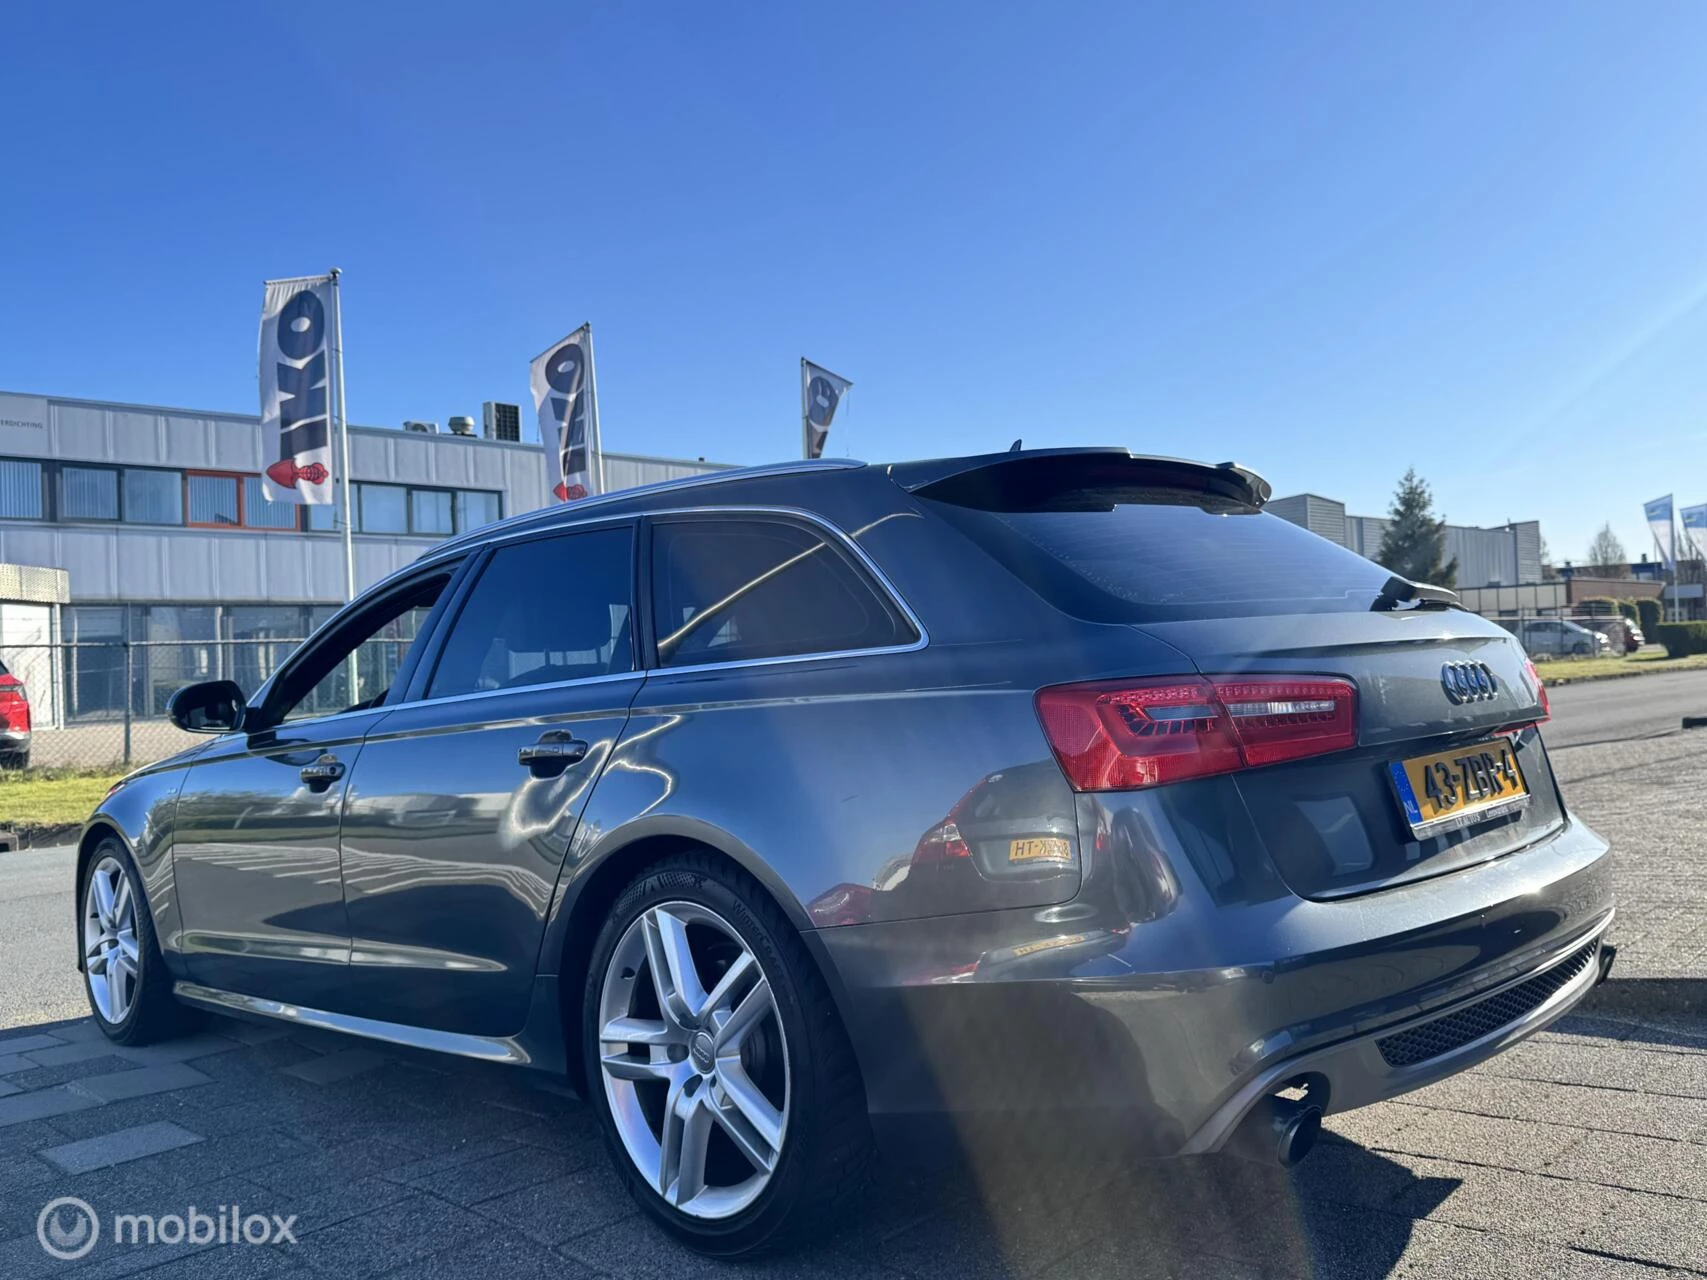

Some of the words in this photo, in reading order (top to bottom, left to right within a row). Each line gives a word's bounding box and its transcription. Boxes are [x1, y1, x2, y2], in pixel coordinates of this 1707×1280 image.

[277, 290, 328, 459] IKO
[1404, 801, 1418, 815] NL
[1424, 749, 1519, 809] 43-ZBR-4
